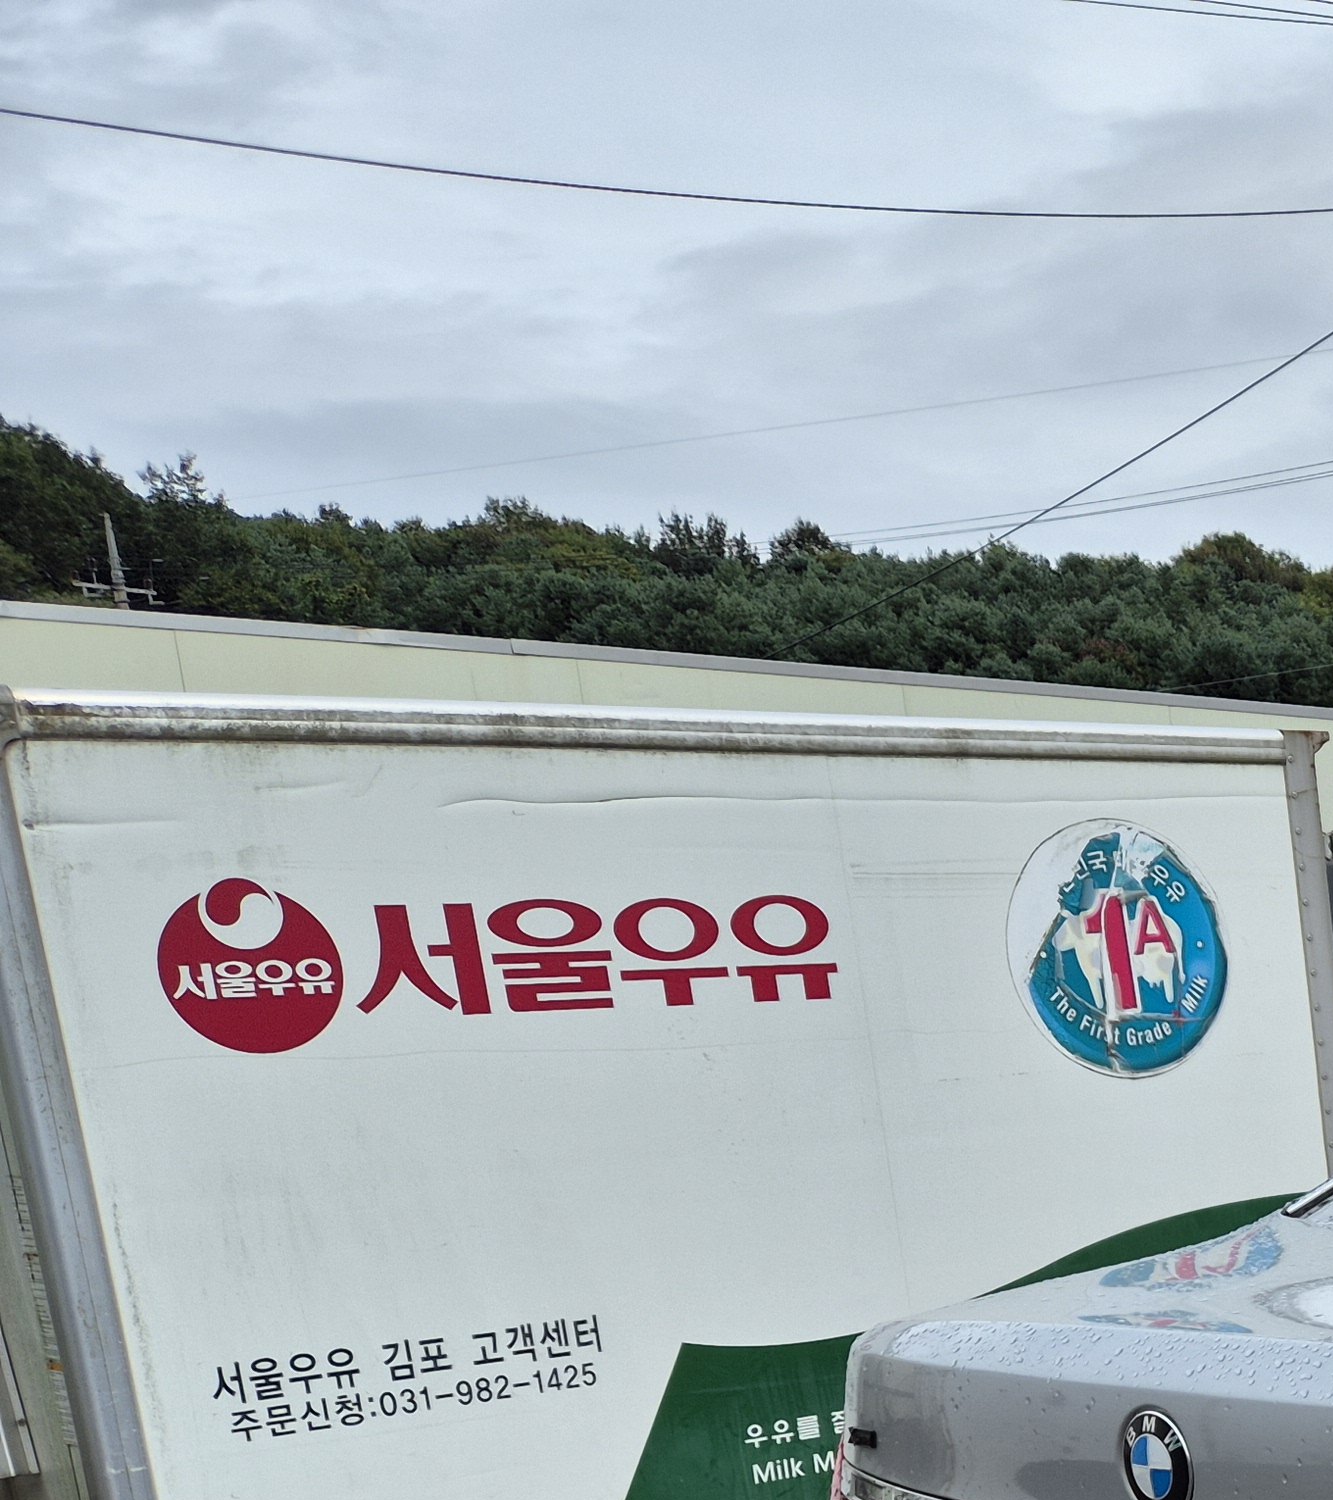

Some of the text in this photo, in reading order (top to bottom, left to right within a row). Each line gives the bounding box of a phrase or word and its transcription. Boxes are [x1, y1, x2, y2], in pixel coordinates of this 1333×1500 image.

[172, 957, 336, 1001] 서울우유
[355, 894, 839, 1017] 서울우유
[1050, 985, 1078, 1022] The
[1125, 1021, 1173, 1046] Grade
[1180, 974, 1209, 1014] Milk
[211, 1314, 604, 1404] 서울우유 김포 고객센터
[230, 1362, 599, 1442] 주문신청:031-982-1425
[743, 1414, 822, 1449] 우유를
[1126, 1415, 1183, 1453] BMW
[751, 1457, 806, 1485] Milk
